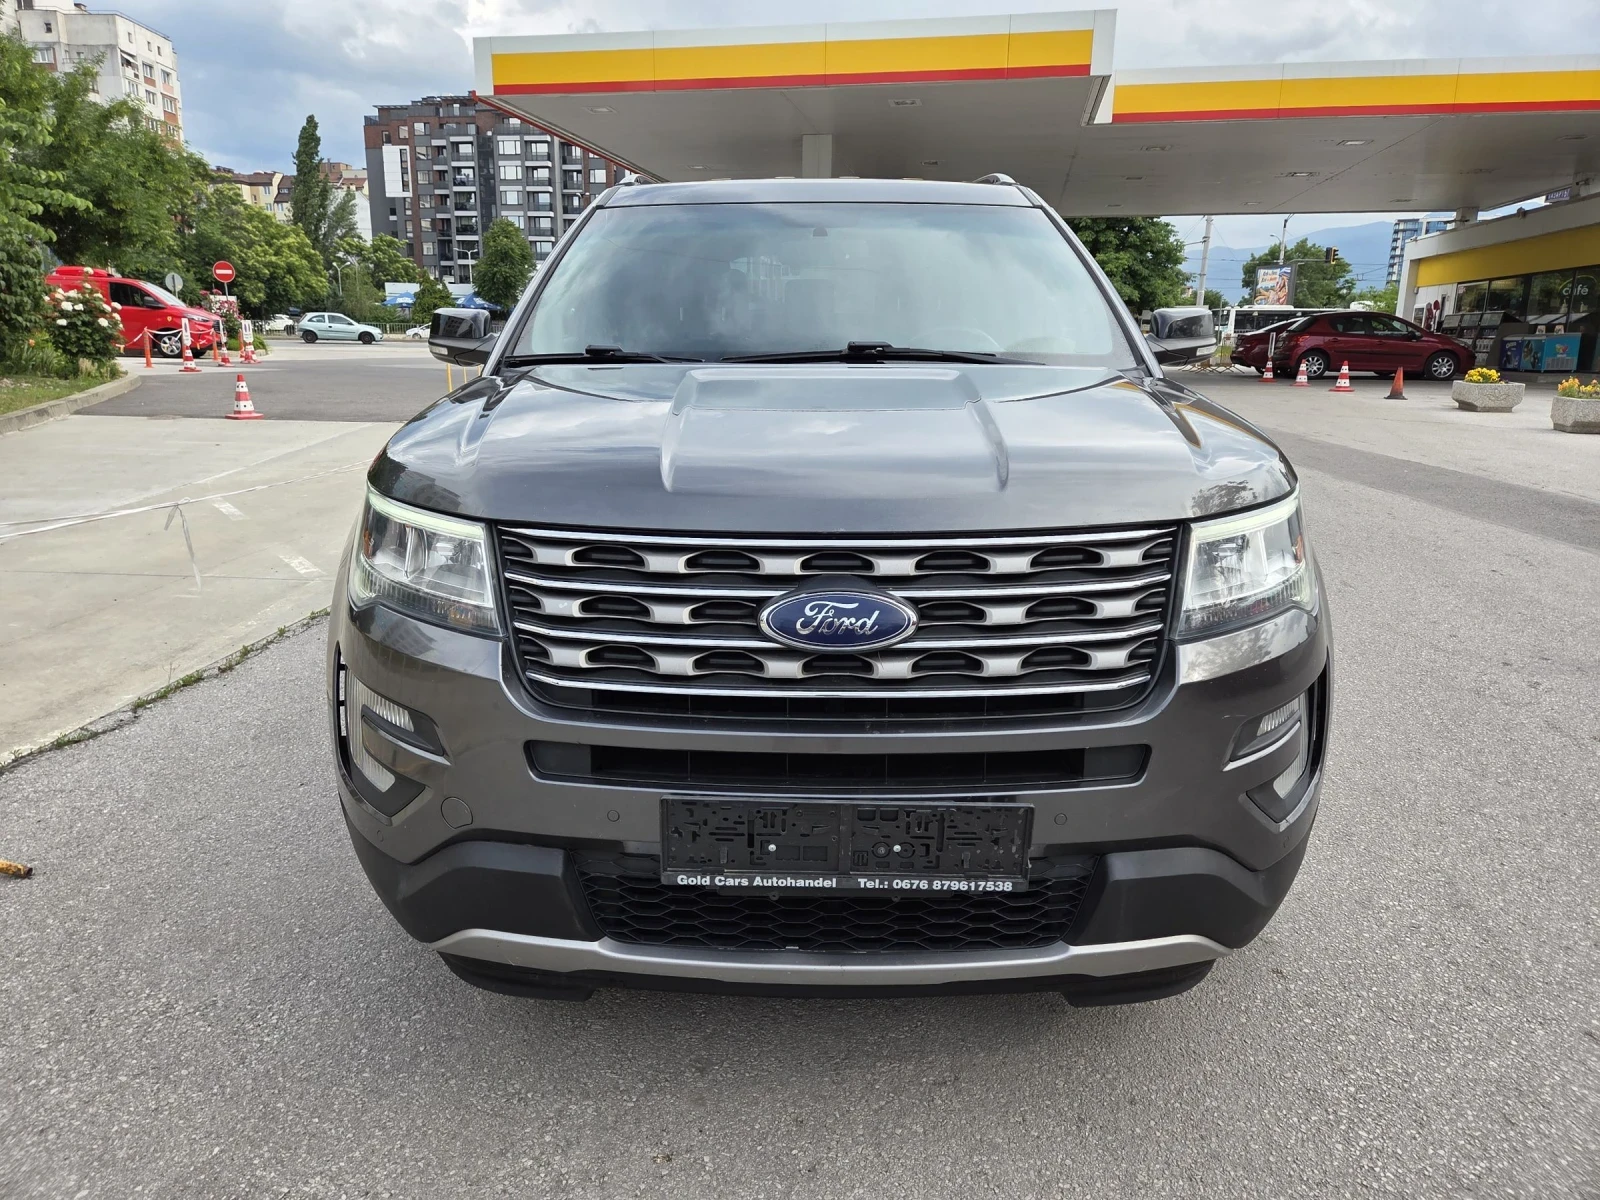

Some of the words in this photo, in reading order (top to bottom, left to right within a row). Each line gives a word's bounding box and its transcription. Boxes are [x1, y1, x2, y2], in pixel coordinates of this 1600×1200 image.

[795, 600, 880, 635] Ford
[676, 875, 711, 886] Gold
[714, 876, 749, 887] Cars
[753, 876, 837, 888] Autohandel
[857, 878, 889, 889] Tel.:
[893, 879, 929, 890] 0676
[932, 880, 1013, 892] 879617538
